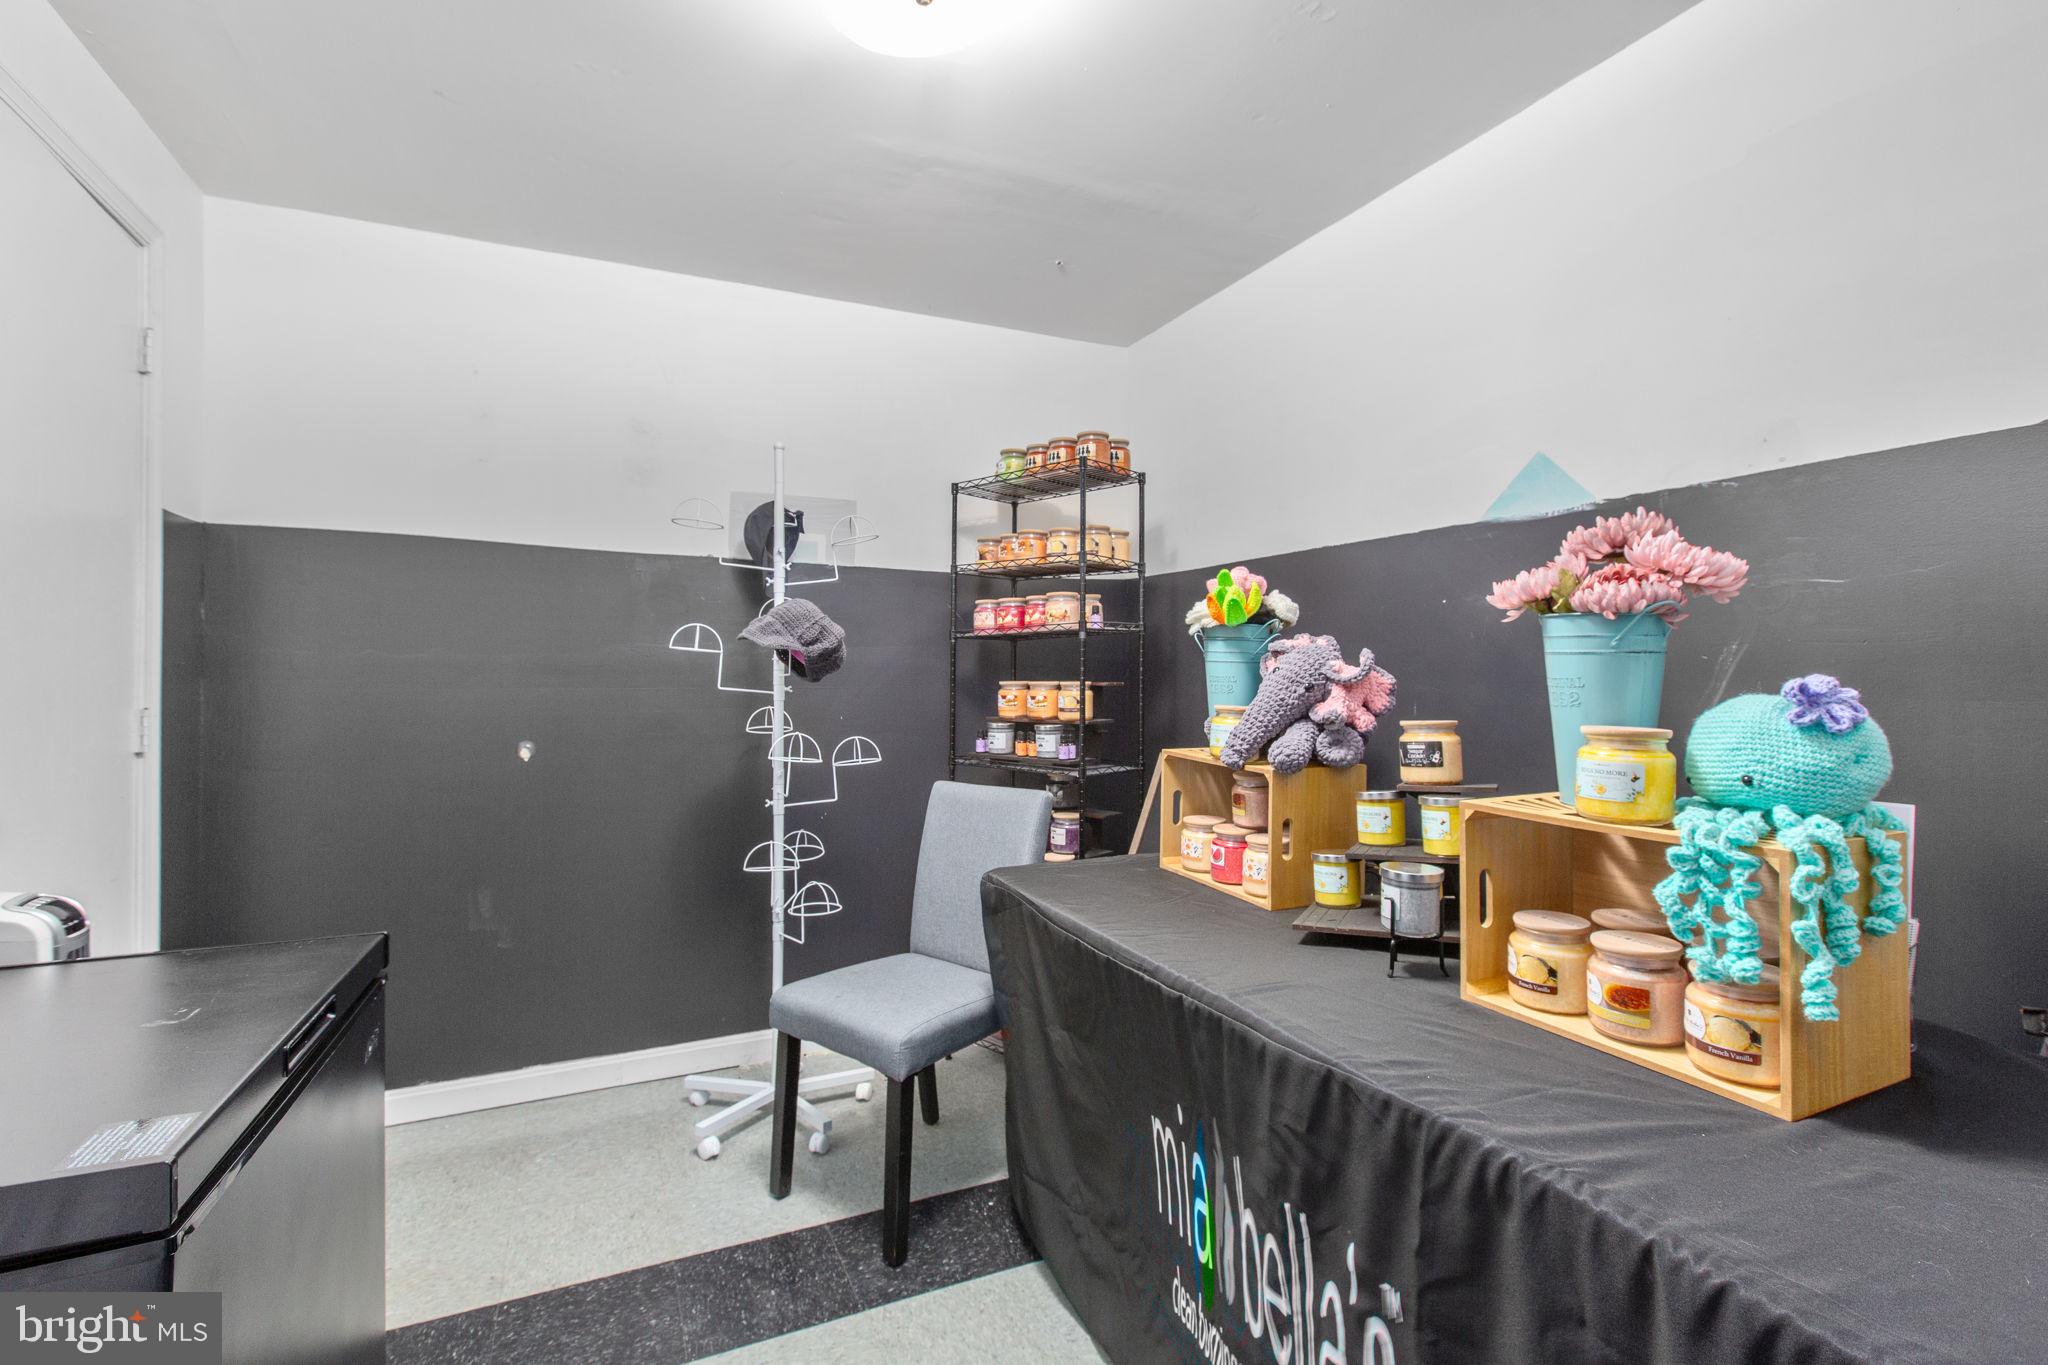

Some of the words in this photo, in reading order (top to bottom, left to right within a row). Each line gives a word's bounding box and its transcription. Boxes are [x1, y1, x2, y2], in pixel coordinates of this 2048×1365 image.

[1708, 1045, 1729, 1058] French
[1729, 1052, 1753, 1063] Vanilla
[1172, 1265, 1199, 1340] clean
